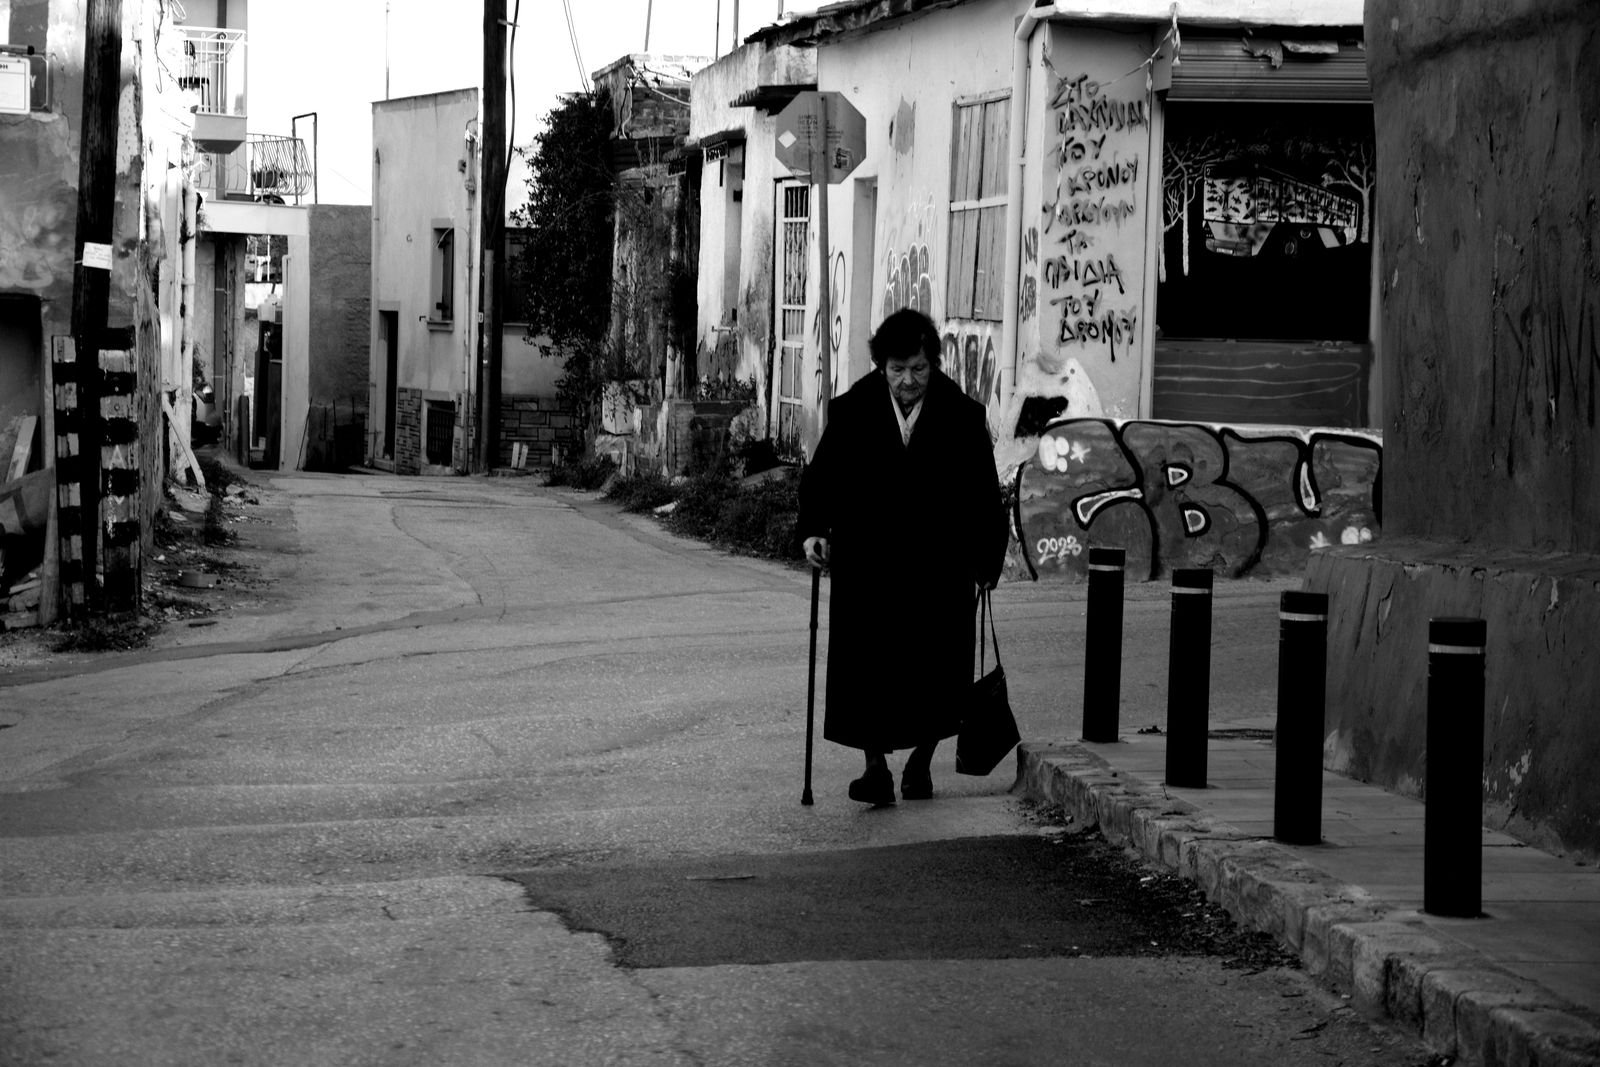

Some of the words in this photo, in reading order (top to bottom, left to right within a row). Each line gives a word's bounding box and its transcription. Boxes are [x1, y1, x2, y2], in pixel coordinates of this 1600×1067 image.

[1052, 133, 1106, 164] ΤΟΥ
[1067, 156, 1138, 197] ΧΡΟΝΟΥ
[1049, 288, 1102, 318] ΤΟΥ
[1058, 306, 1137, 363] ΔΡΟΜΟΥ
[1037, 535, 1082, 565] 2023
